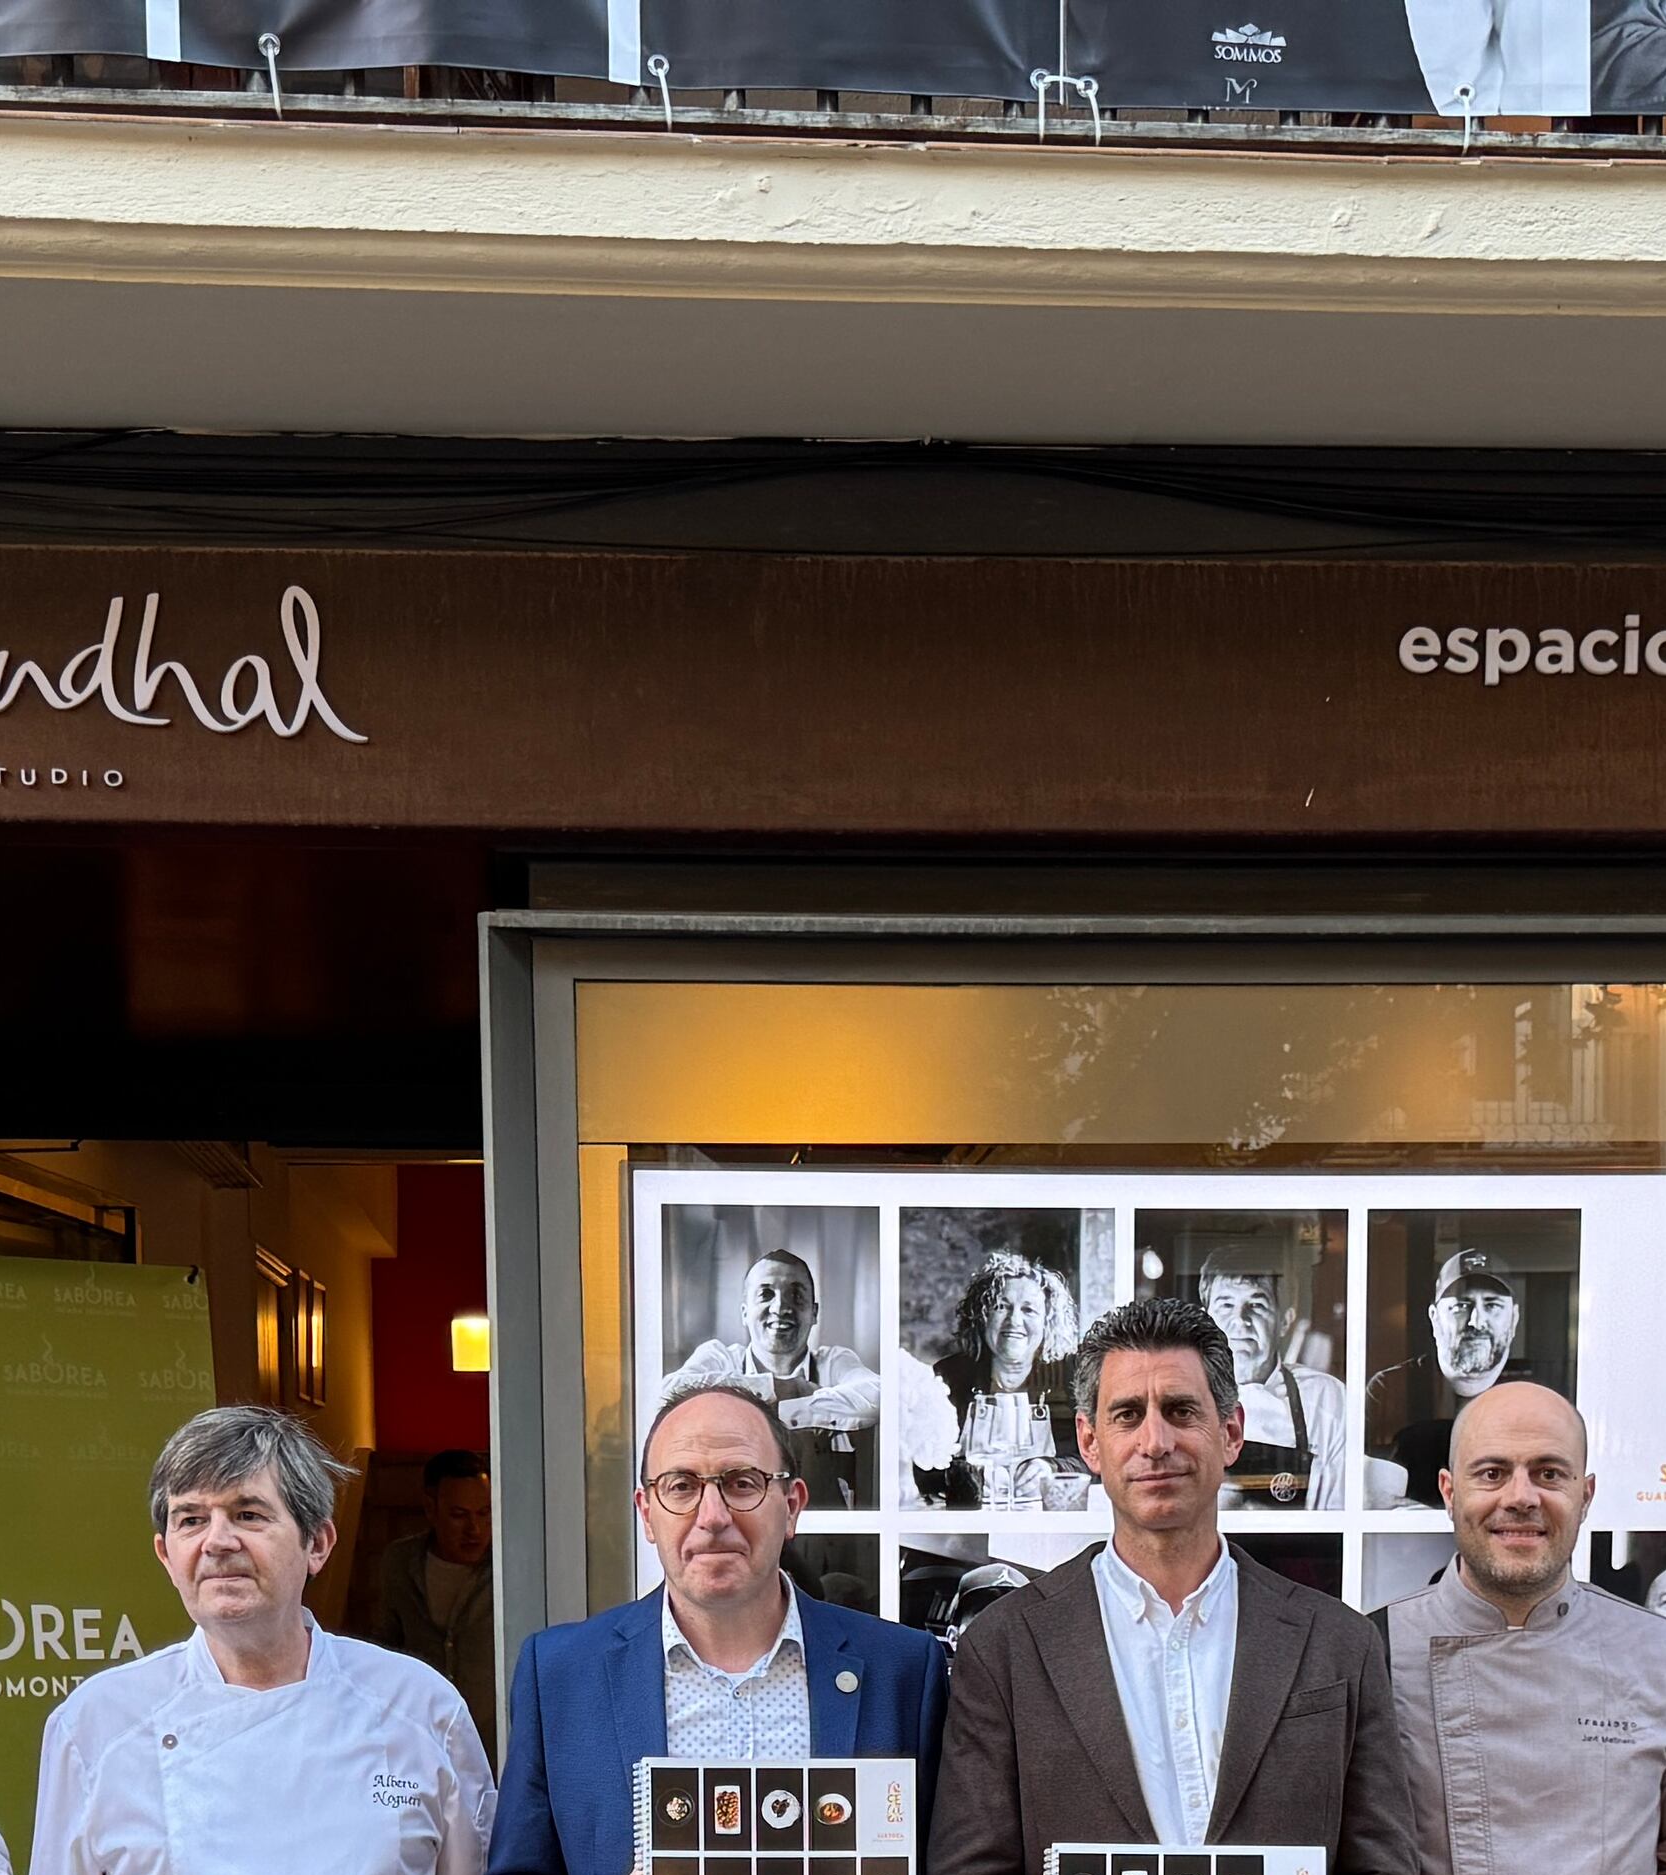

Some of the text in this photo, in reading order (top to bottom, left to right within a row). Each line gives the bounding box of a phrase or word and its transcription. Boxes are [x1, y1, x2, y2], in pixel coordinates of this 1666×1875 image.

[1213, 45, 1282, 63] SOMMOS
[54, 1286, 137, 1307] SABOREA
[3, 1361, 107, 1387] SABOREA
[373, 1774, 419, 1790] Alberto
